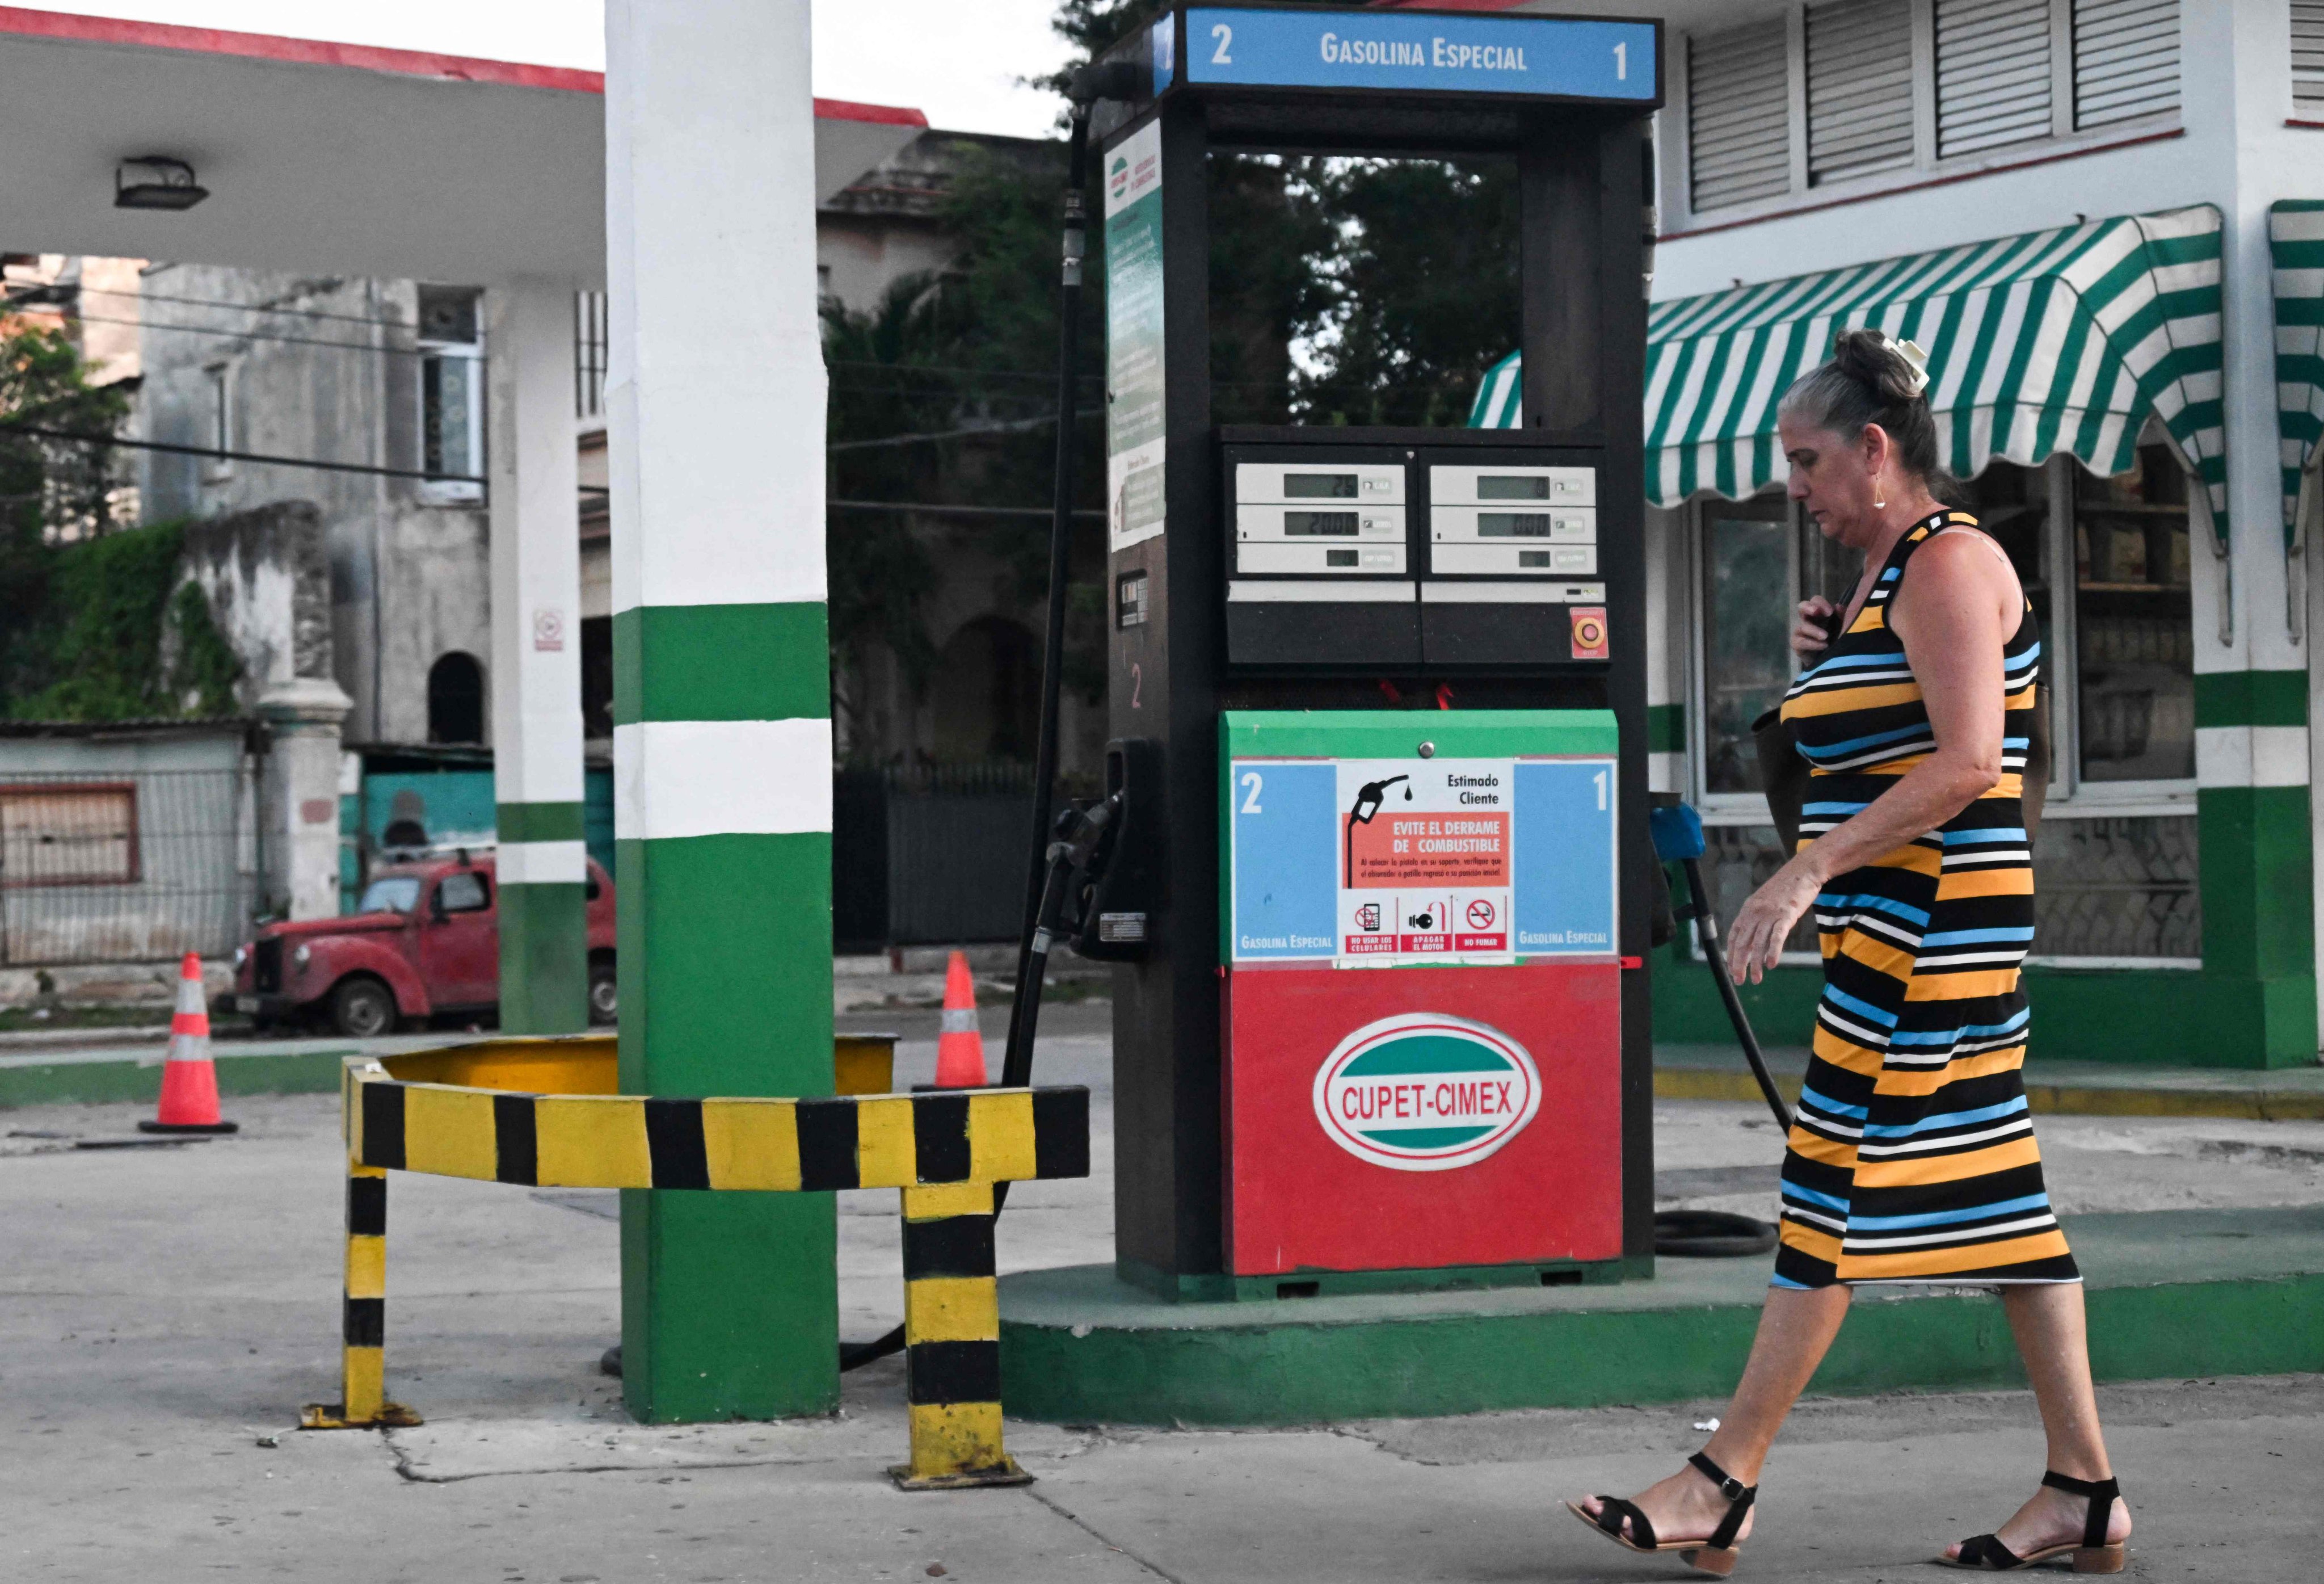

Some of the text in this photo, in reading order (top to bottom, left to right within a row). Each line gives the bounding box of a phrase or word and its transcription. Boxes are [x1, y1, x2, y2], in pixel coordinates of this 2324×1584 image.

[1211, 24, 1626, 80] 2 GASOLINA ESPECIAL 1
[1448, 774, 1499, 788] Estimado
[1241, 772, 1263, 814] 2
[1593, 770, 1607, 810] 1
[1459, 792, 1499, 805] Cliente
[1393, 821, 1500, 835] EVITE EL DERRAME
[1393, 839, 1500, 853] DE COMBUSTIBLE
[1464, 857, 1489, 866] verifique
[1241, 935, 1333, 949] GASOLINA ESPECIAL
[1519, 930, 1607, 944] GASOLINA ESPECIAL
[1342, 1081, 1513, 1120] CUPET-CIMEX
